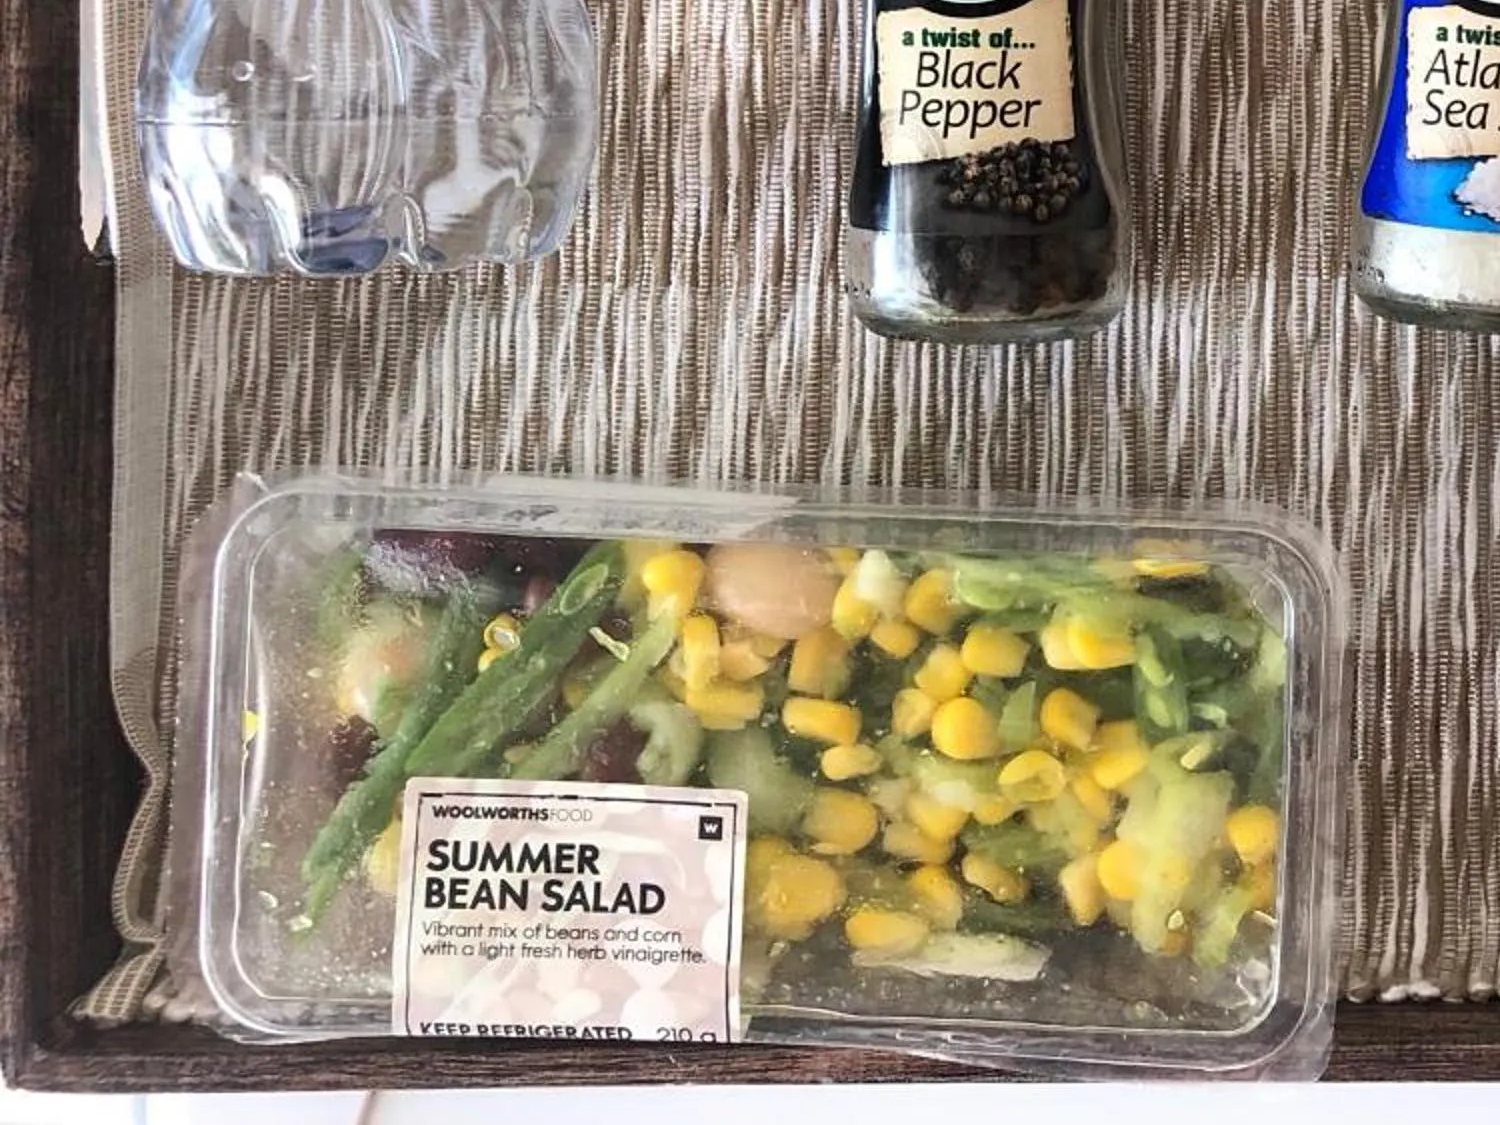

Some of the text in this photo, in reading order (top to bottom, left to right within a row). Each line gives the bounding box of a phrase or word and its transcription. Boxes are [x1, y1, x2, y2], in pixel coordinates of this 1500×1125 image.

[902, 32, 915, 47] a
[921, 28, 981, 49] twist
[1435, 26, 1449, 42] a
[916, 51, 1022, 90] Black
[899, 89, 1042, 139] Pepper
[1423, 89, 1488, 129] Sea
[432, 805, 593, 822] WOOLWORTHSFOOD
[426, 839, 600, 875] SUMMER
[424, 877, 666, 914] BEAN SALAD
[422, 921, 682, 944] Vibrant mix of beans and corn
[420, 941, 707, 965] with a light fresh herb vinaigrette.
